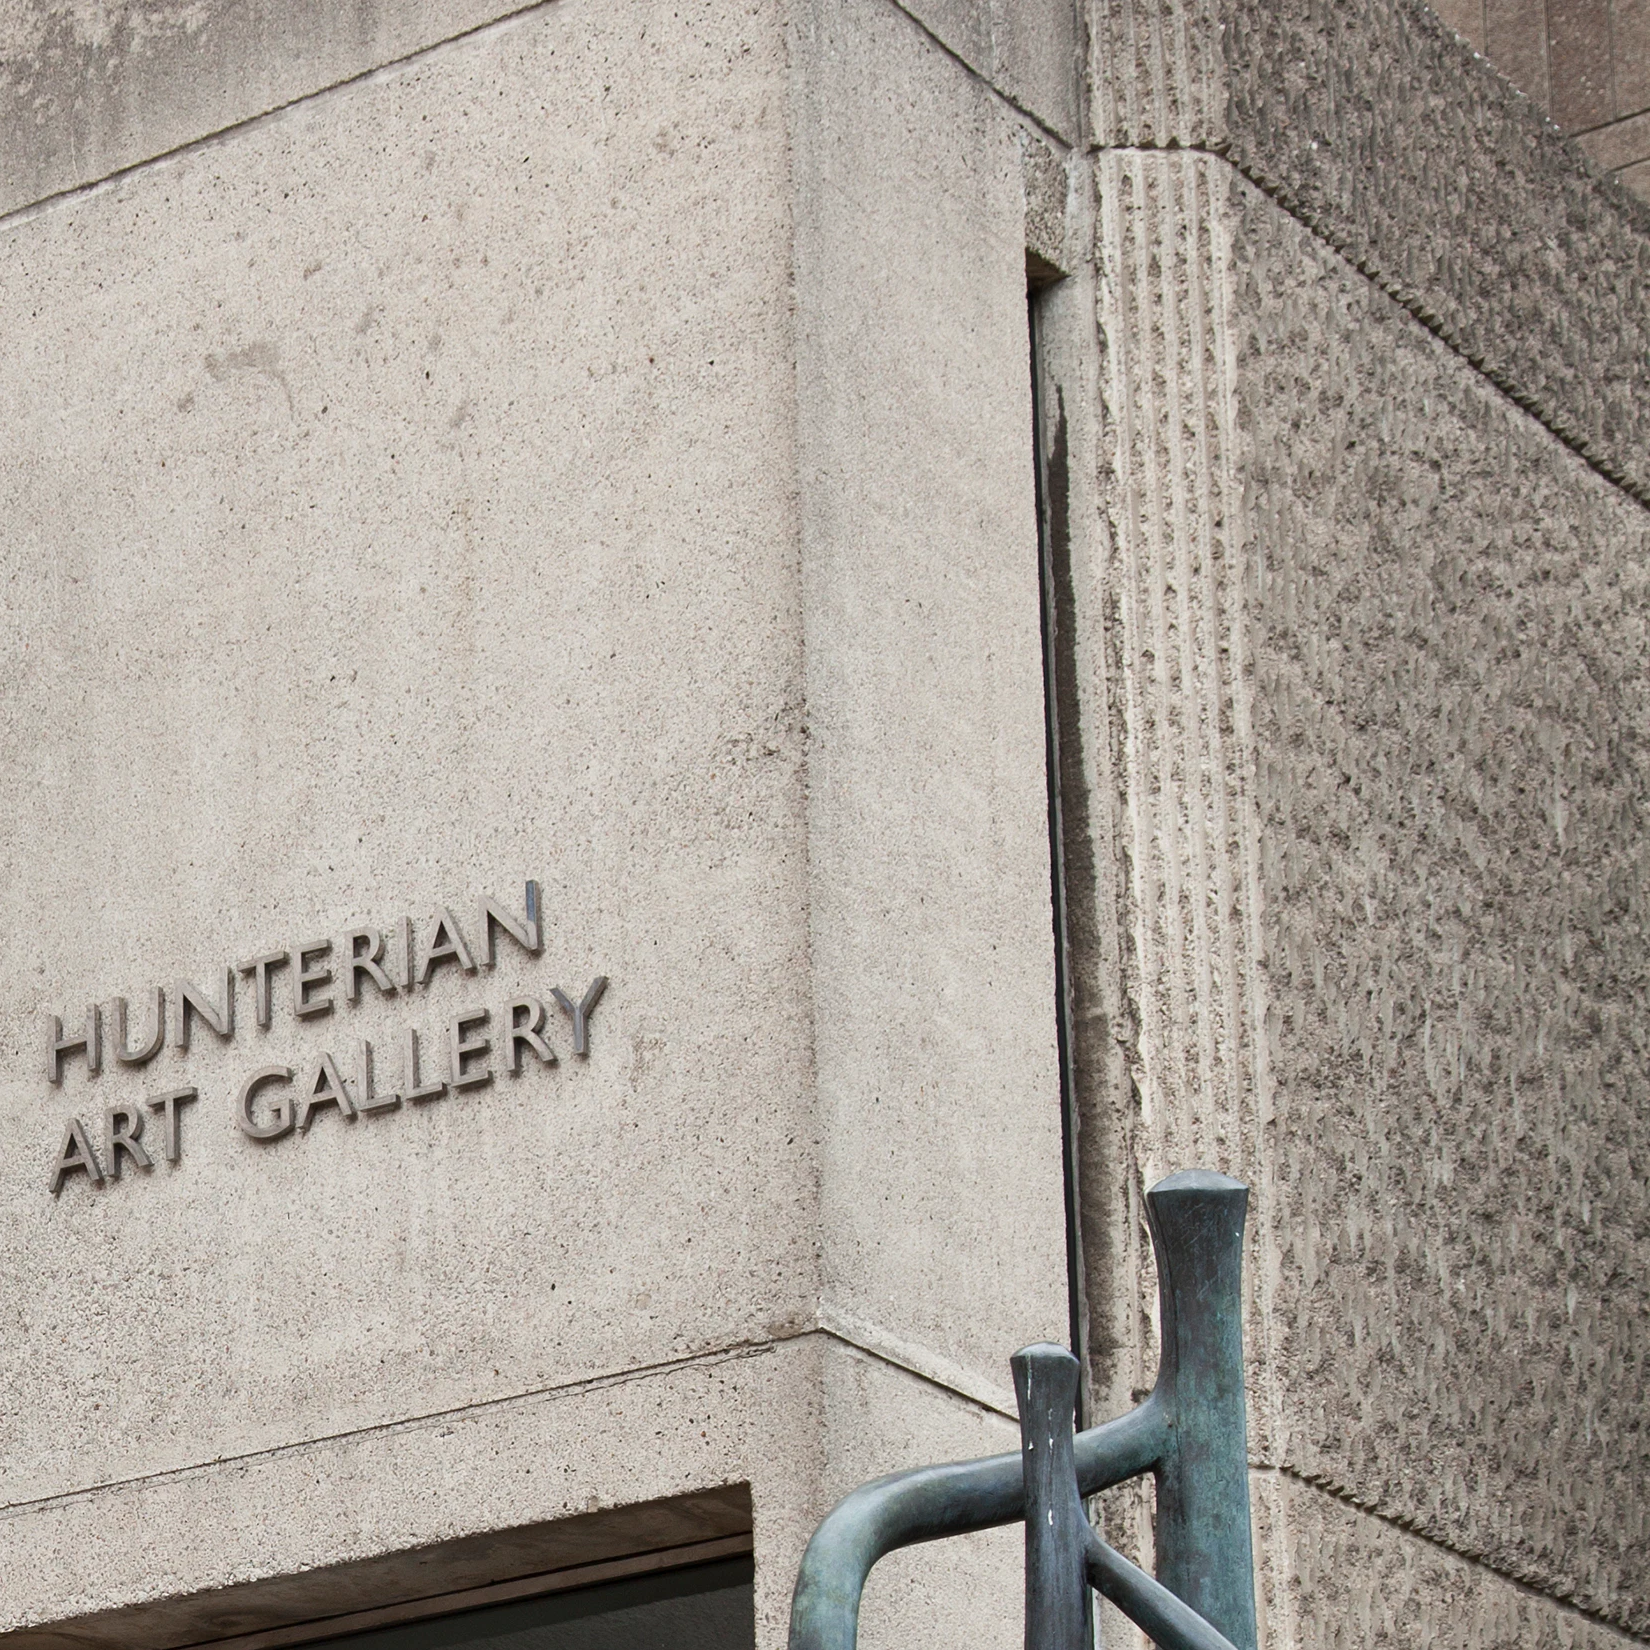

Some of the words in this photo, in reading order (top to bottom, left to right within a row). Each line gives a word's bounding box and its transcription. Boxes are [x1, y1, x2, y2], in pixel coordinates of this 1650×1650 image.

[50, 879, 542, 1084] HUNTERIAN
[50, 1086, 198, 1195] ART
[236, 976, 608, 1140] GALLERY
